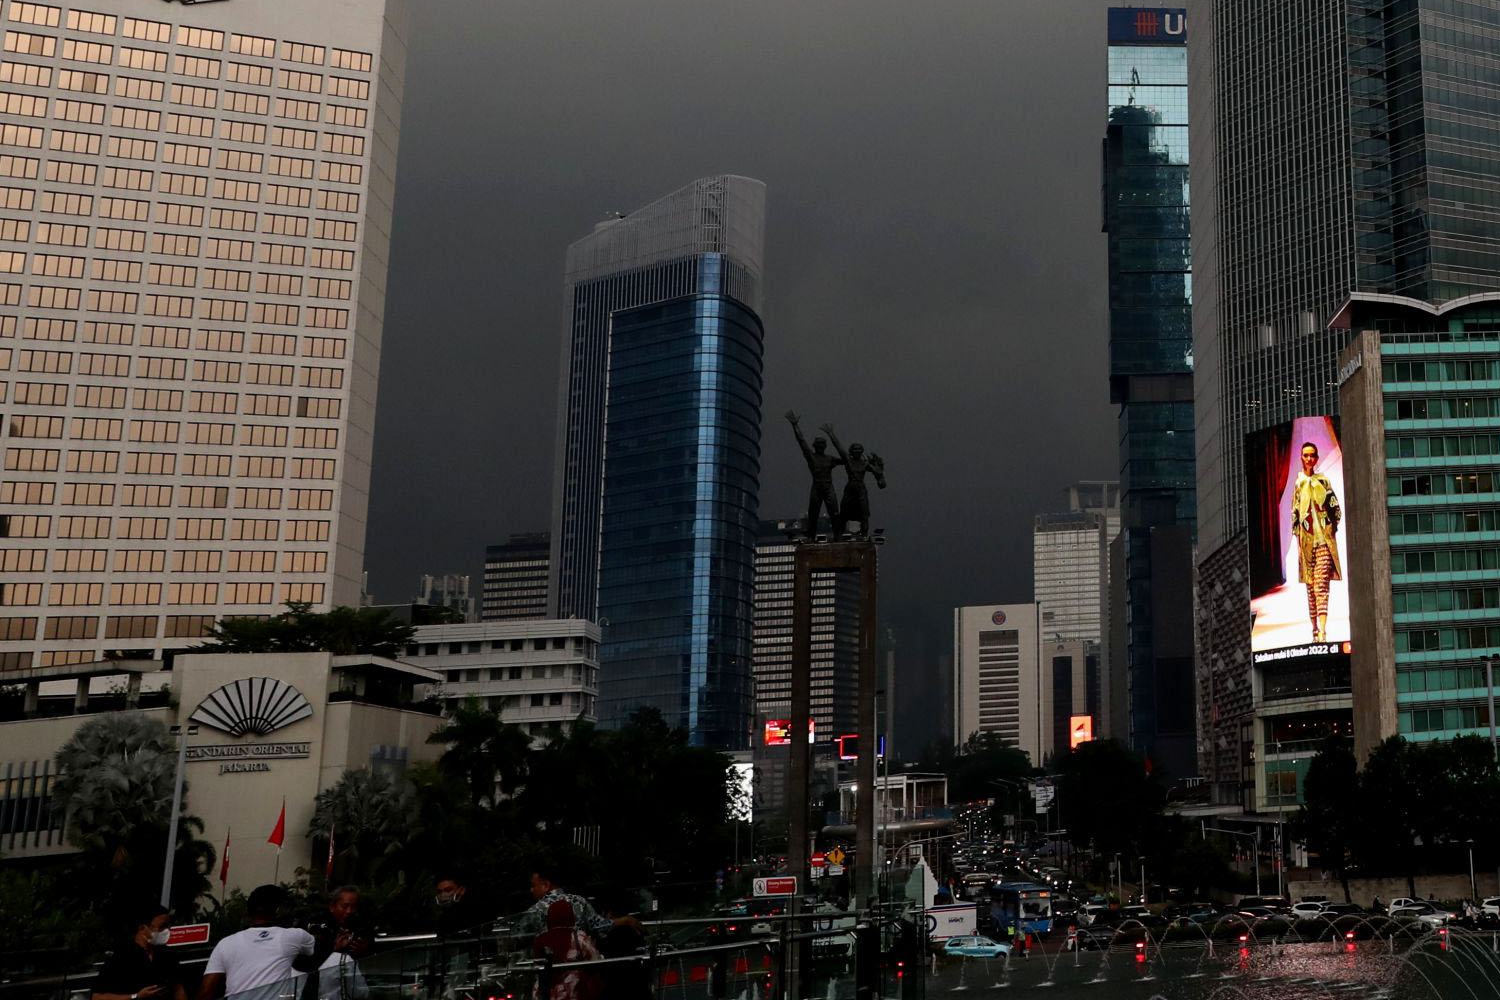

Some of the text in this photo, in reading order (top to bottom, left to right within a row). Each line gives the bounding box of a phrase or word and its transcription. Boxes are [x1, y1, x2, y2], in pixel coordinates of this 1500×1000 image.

[1164, 13, 1187, 35] U
[1309, 644, 1329, 656] 2022
[1330, 644, 1339, 654] di
[252, 744, 310, 755] ORIENTAL
[219, 762, 271, 775] JAKARTA
